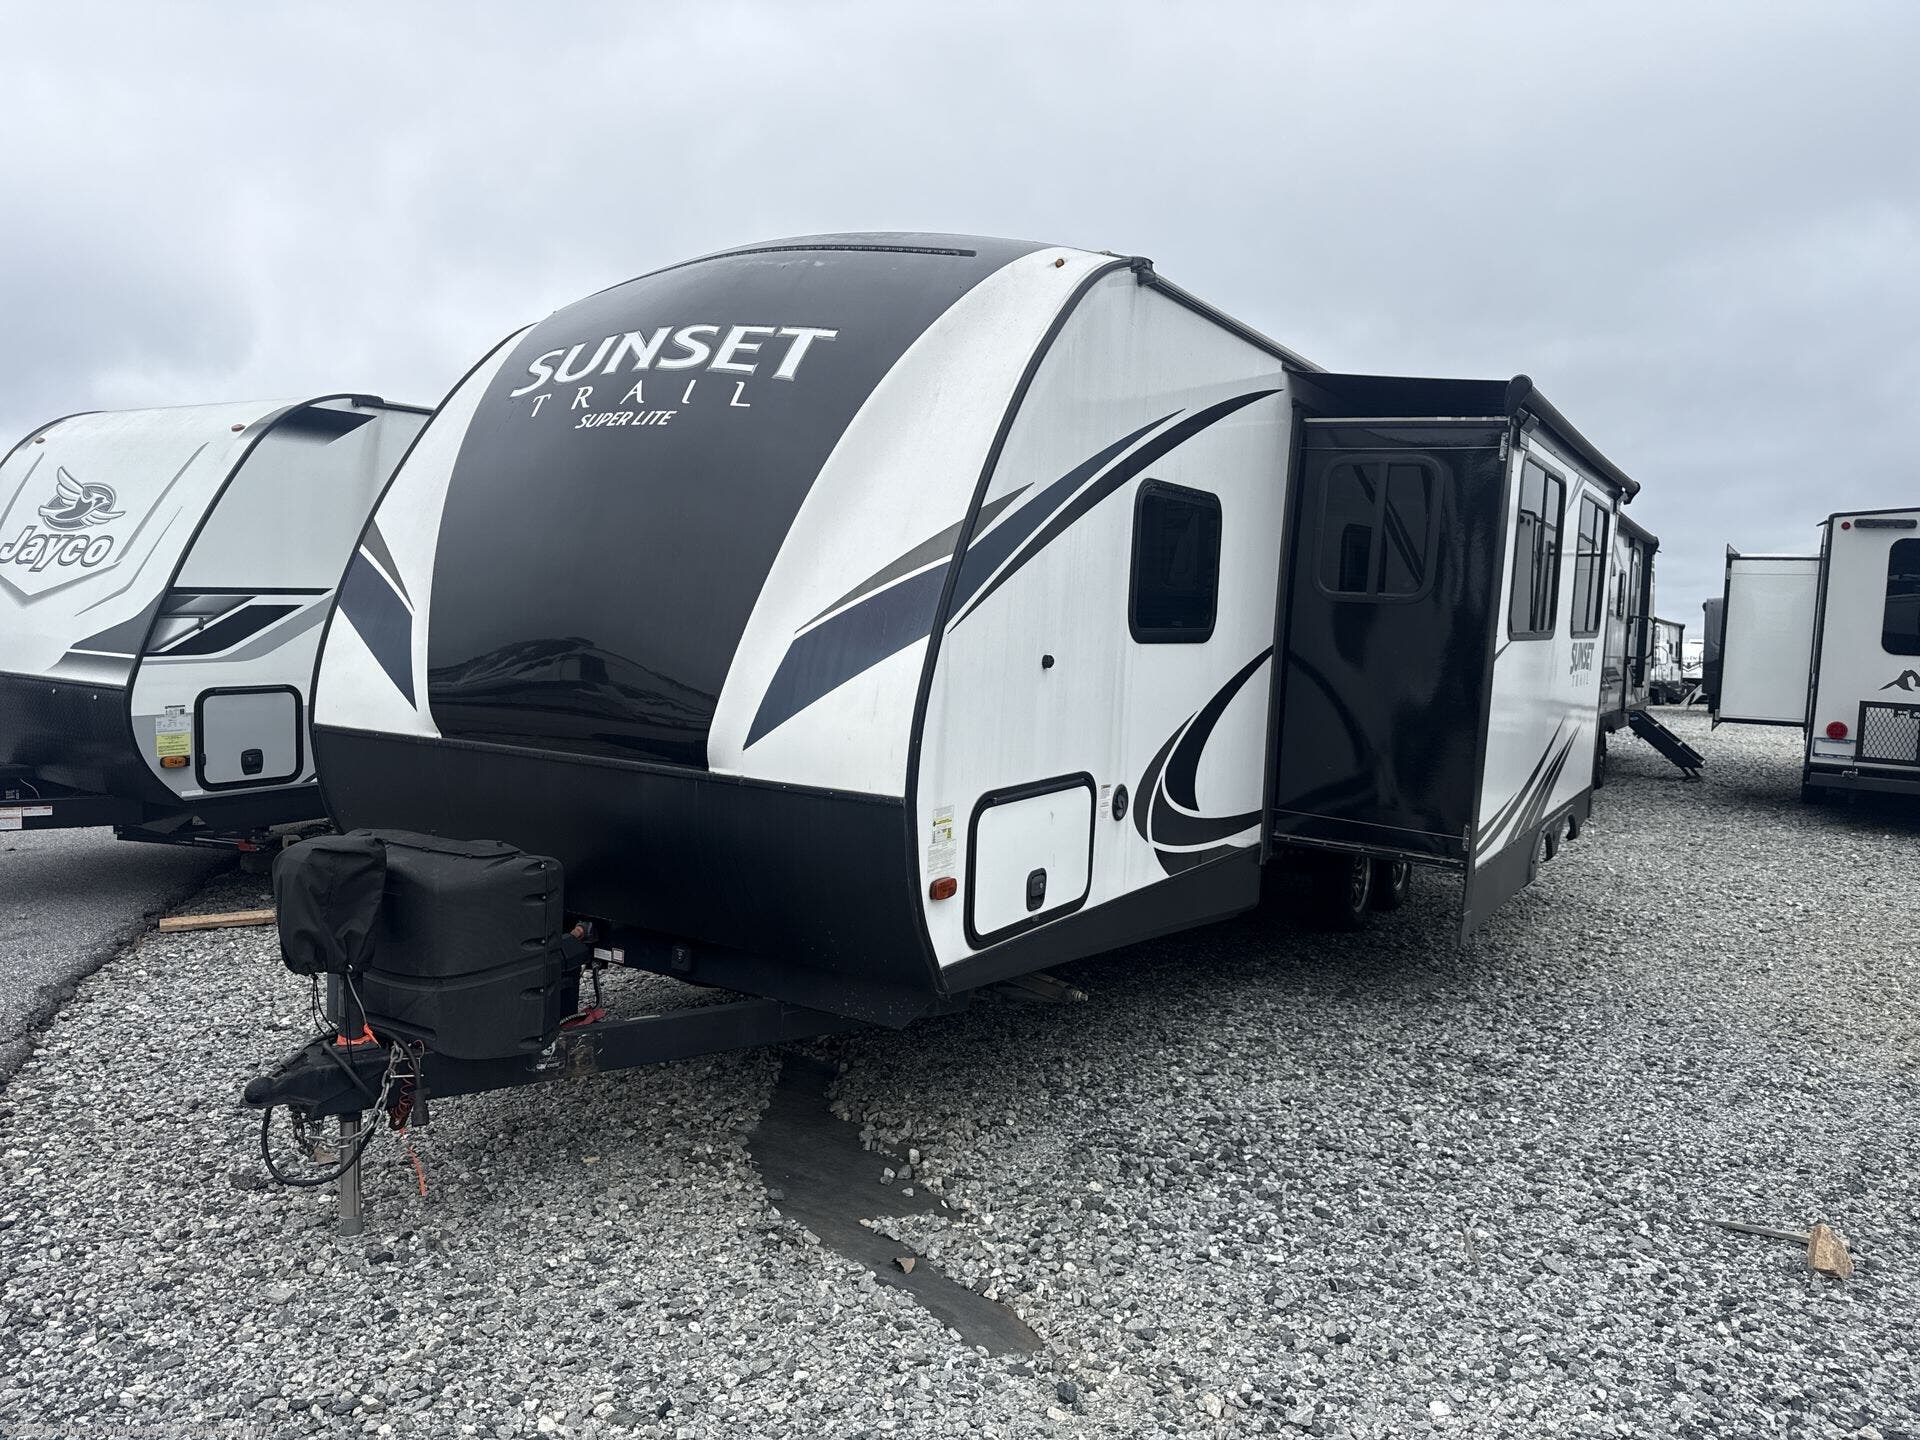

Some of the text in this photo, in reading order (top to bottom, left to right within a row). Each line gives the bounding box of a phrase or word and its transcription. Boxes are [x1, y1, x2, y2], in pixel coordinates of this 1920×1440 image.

[509, 323, 841, 399] SUNSET
[531, 379, 751, 418] TRAIL
[574, 410, 678, 430] SUPER LITE
[0, 525, 115, 573] Jayco
[1570, 642, 1595, 675] SUNSET
